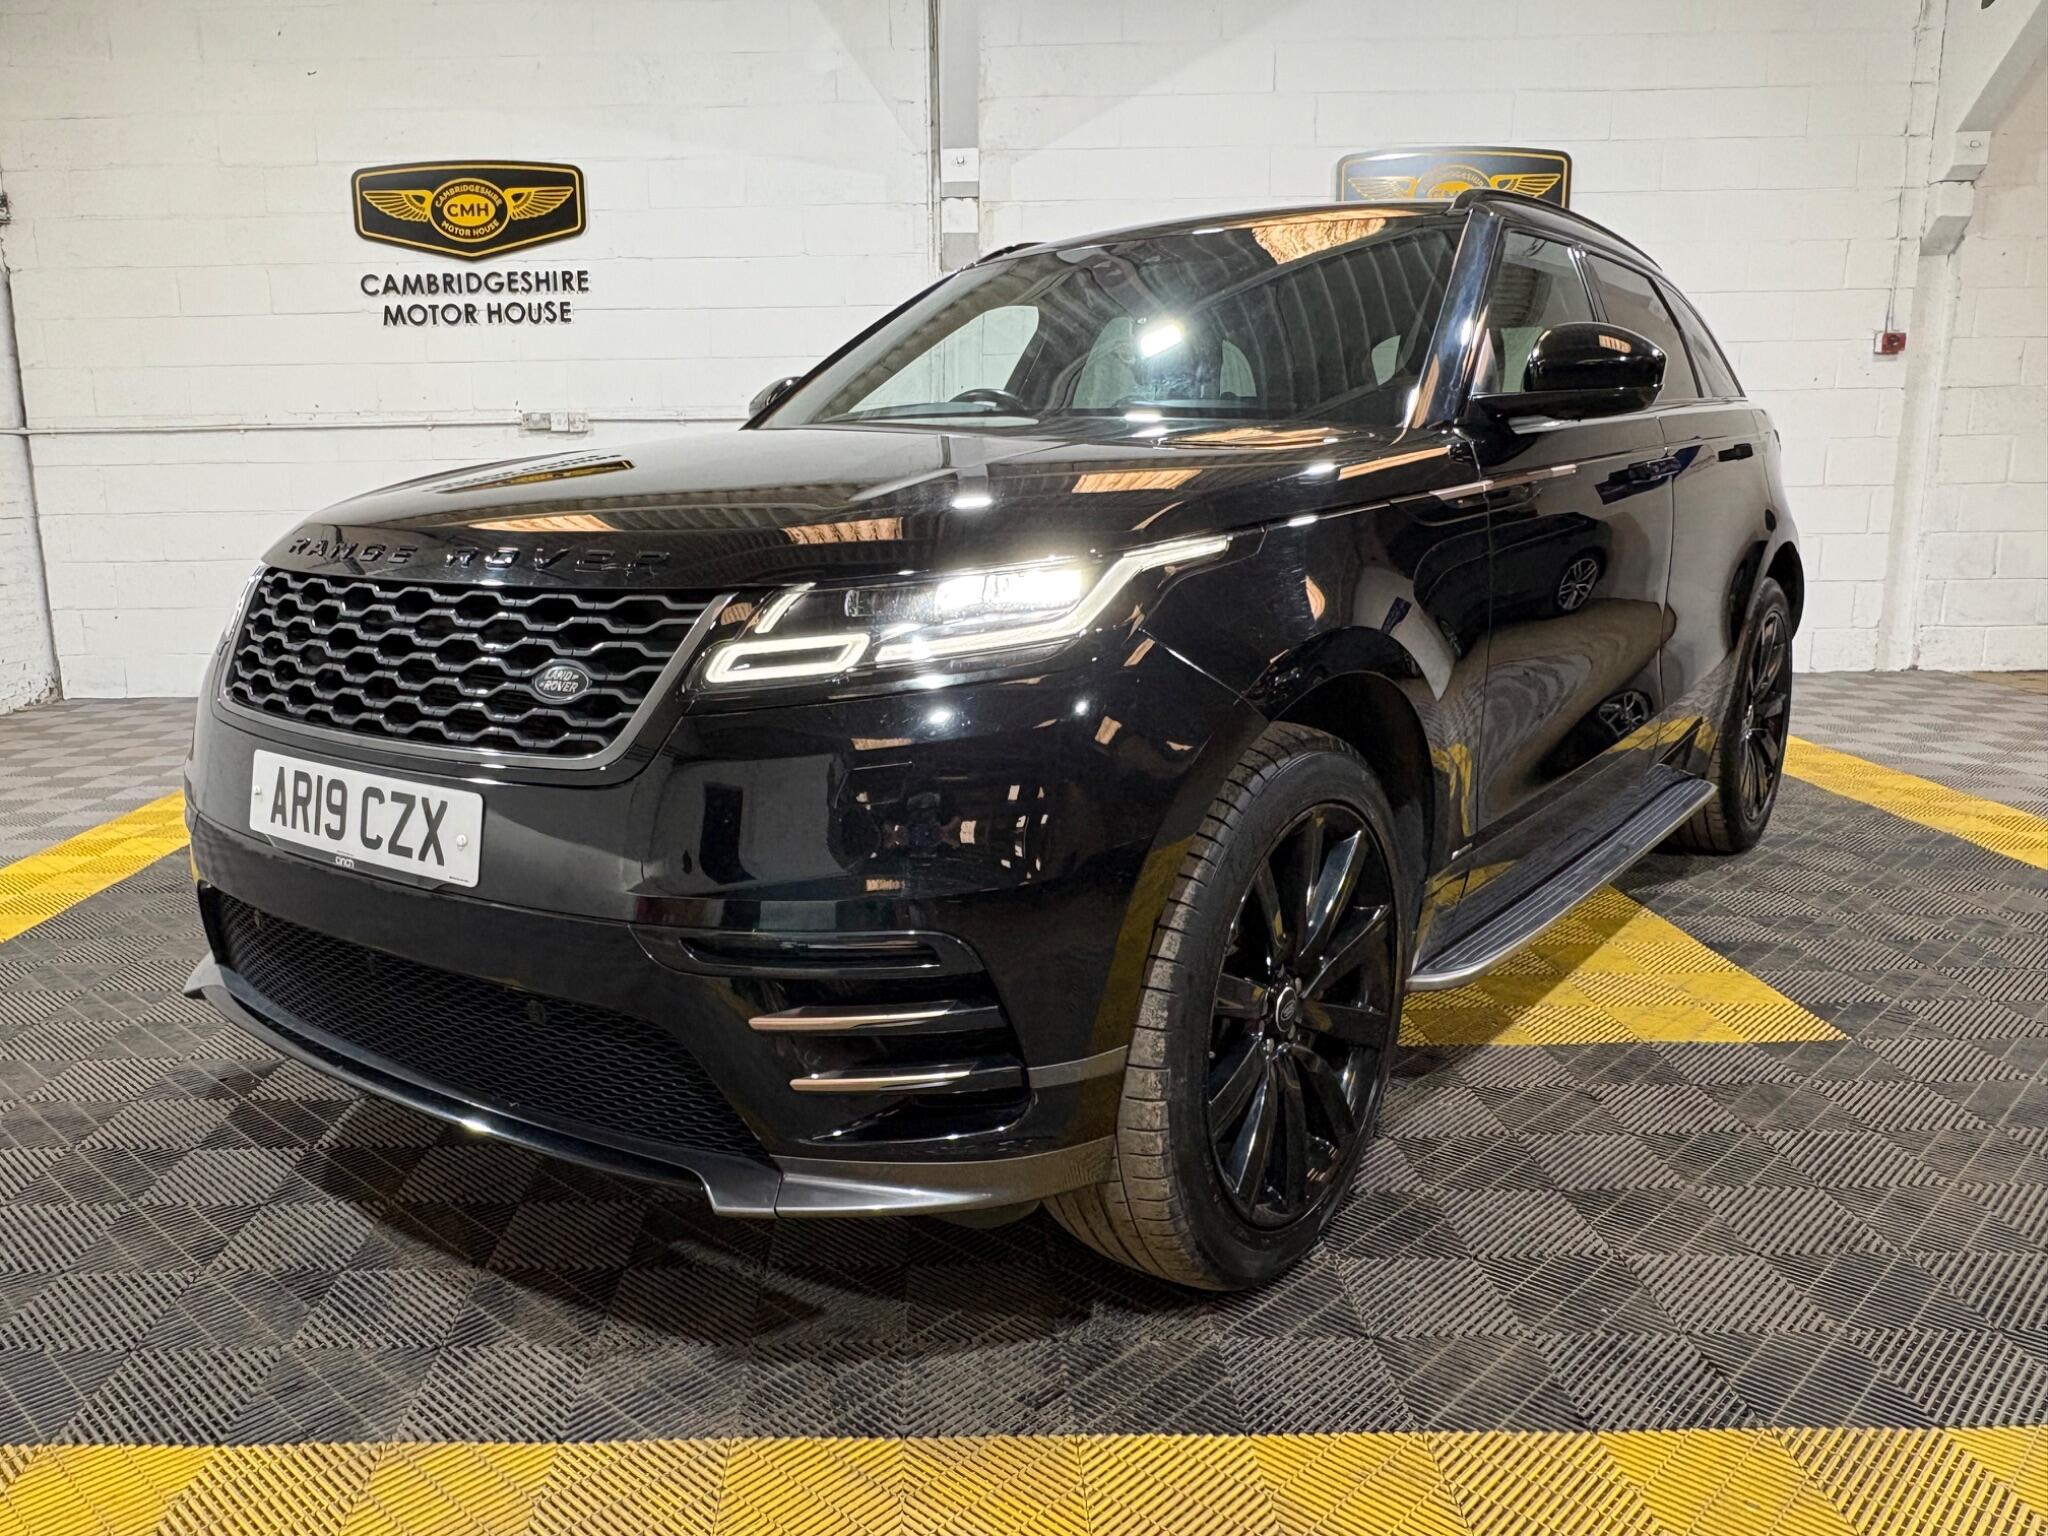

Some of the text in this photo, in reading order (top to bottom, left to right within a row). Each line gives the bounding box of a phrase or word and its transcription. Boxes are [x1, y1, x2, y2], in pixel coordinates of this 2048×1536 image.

[435, 184, 503, 207] CAMBRIDGESHIRE
[447, 203, 489, 217] CMH
[441, 218, 500, 236] MOTOR HOUSE
[361, 270, 590, 297] CAMBRIDGESHIRE
[383, 301, 573, 326] MOTOR HOUSE
[288, 537, 671, 577] RANGE ROVER
[271, 766, 448, 867] AR19 CZX
